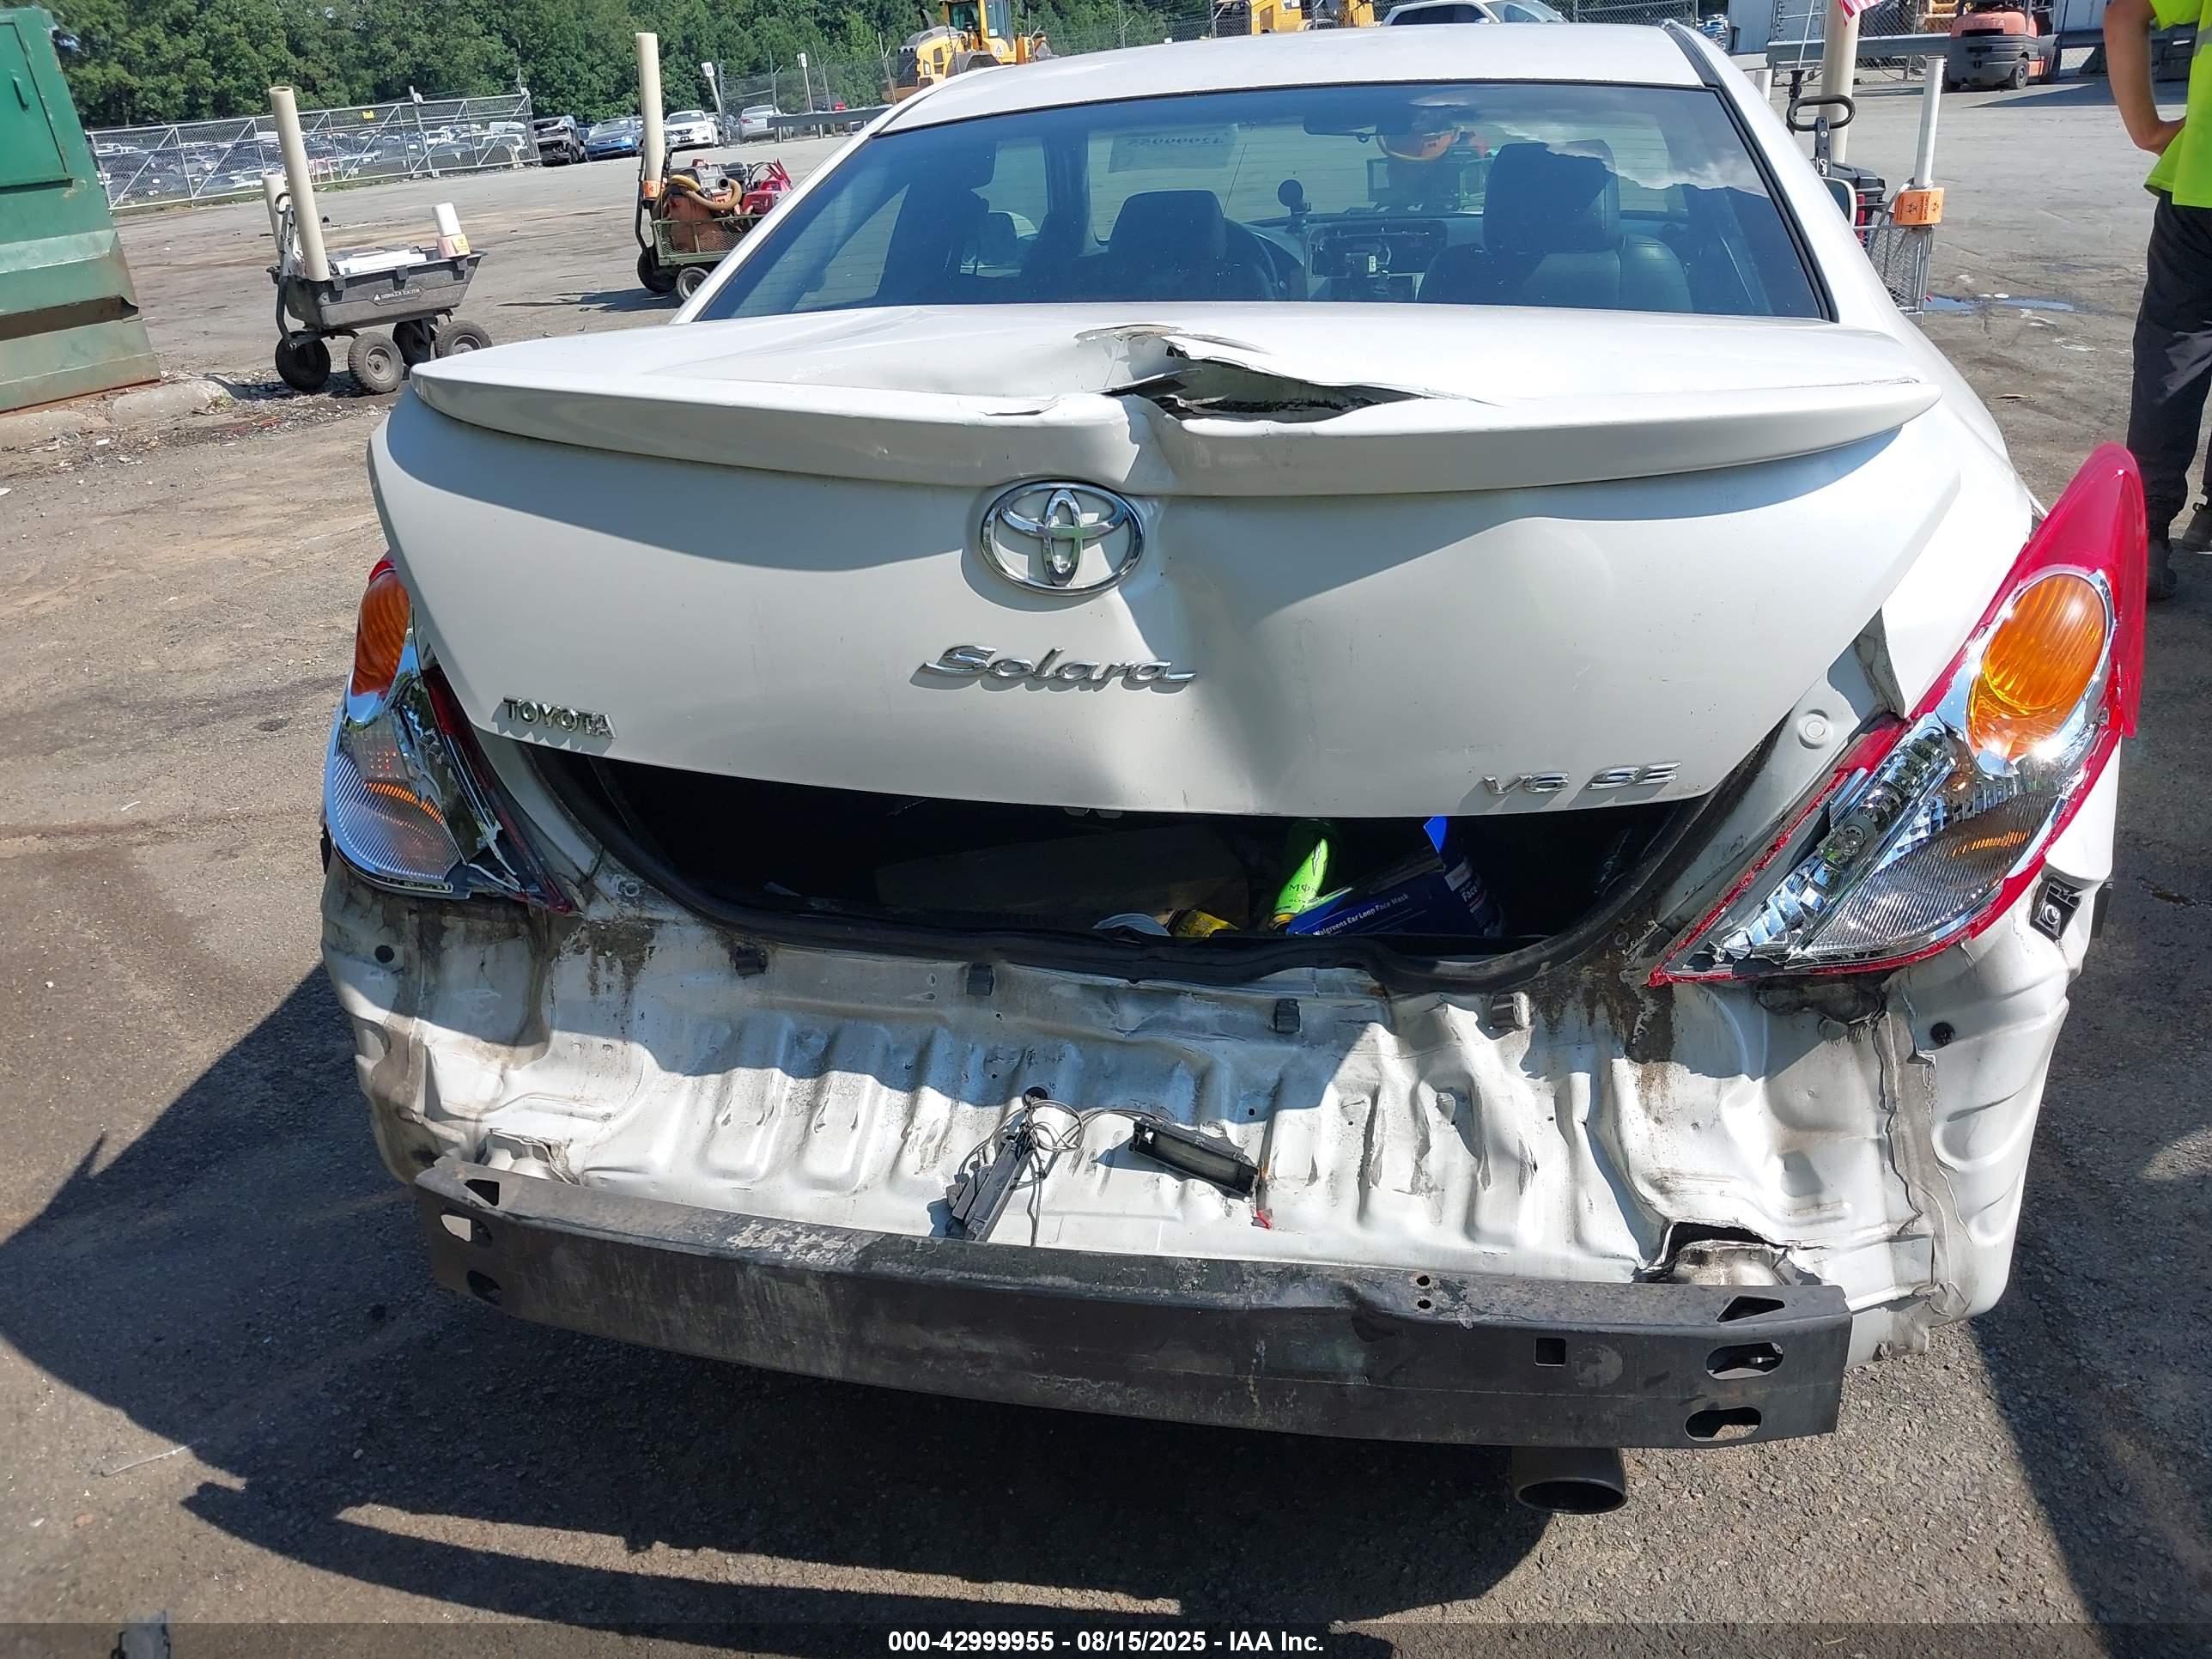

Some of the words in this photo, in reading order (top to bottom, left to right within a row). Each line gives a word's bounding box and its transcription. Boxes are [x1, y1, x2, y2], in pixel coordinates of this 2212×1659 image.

[925, 645, 1196, 682] Solara
[503, 696, 617, 738] TOYOTA
[1483, 771, 1570, 795] V6
[1586, 762, 1681, 790] SE
[1312, 920, 1347, 937] Walgreens
[1347, 914, 1359, 924] Ear
[1358, 907, 1375, 920] Loop
[1375, 901, 1391, 912] Face
[1392, 893, 1409, 906] Mask
